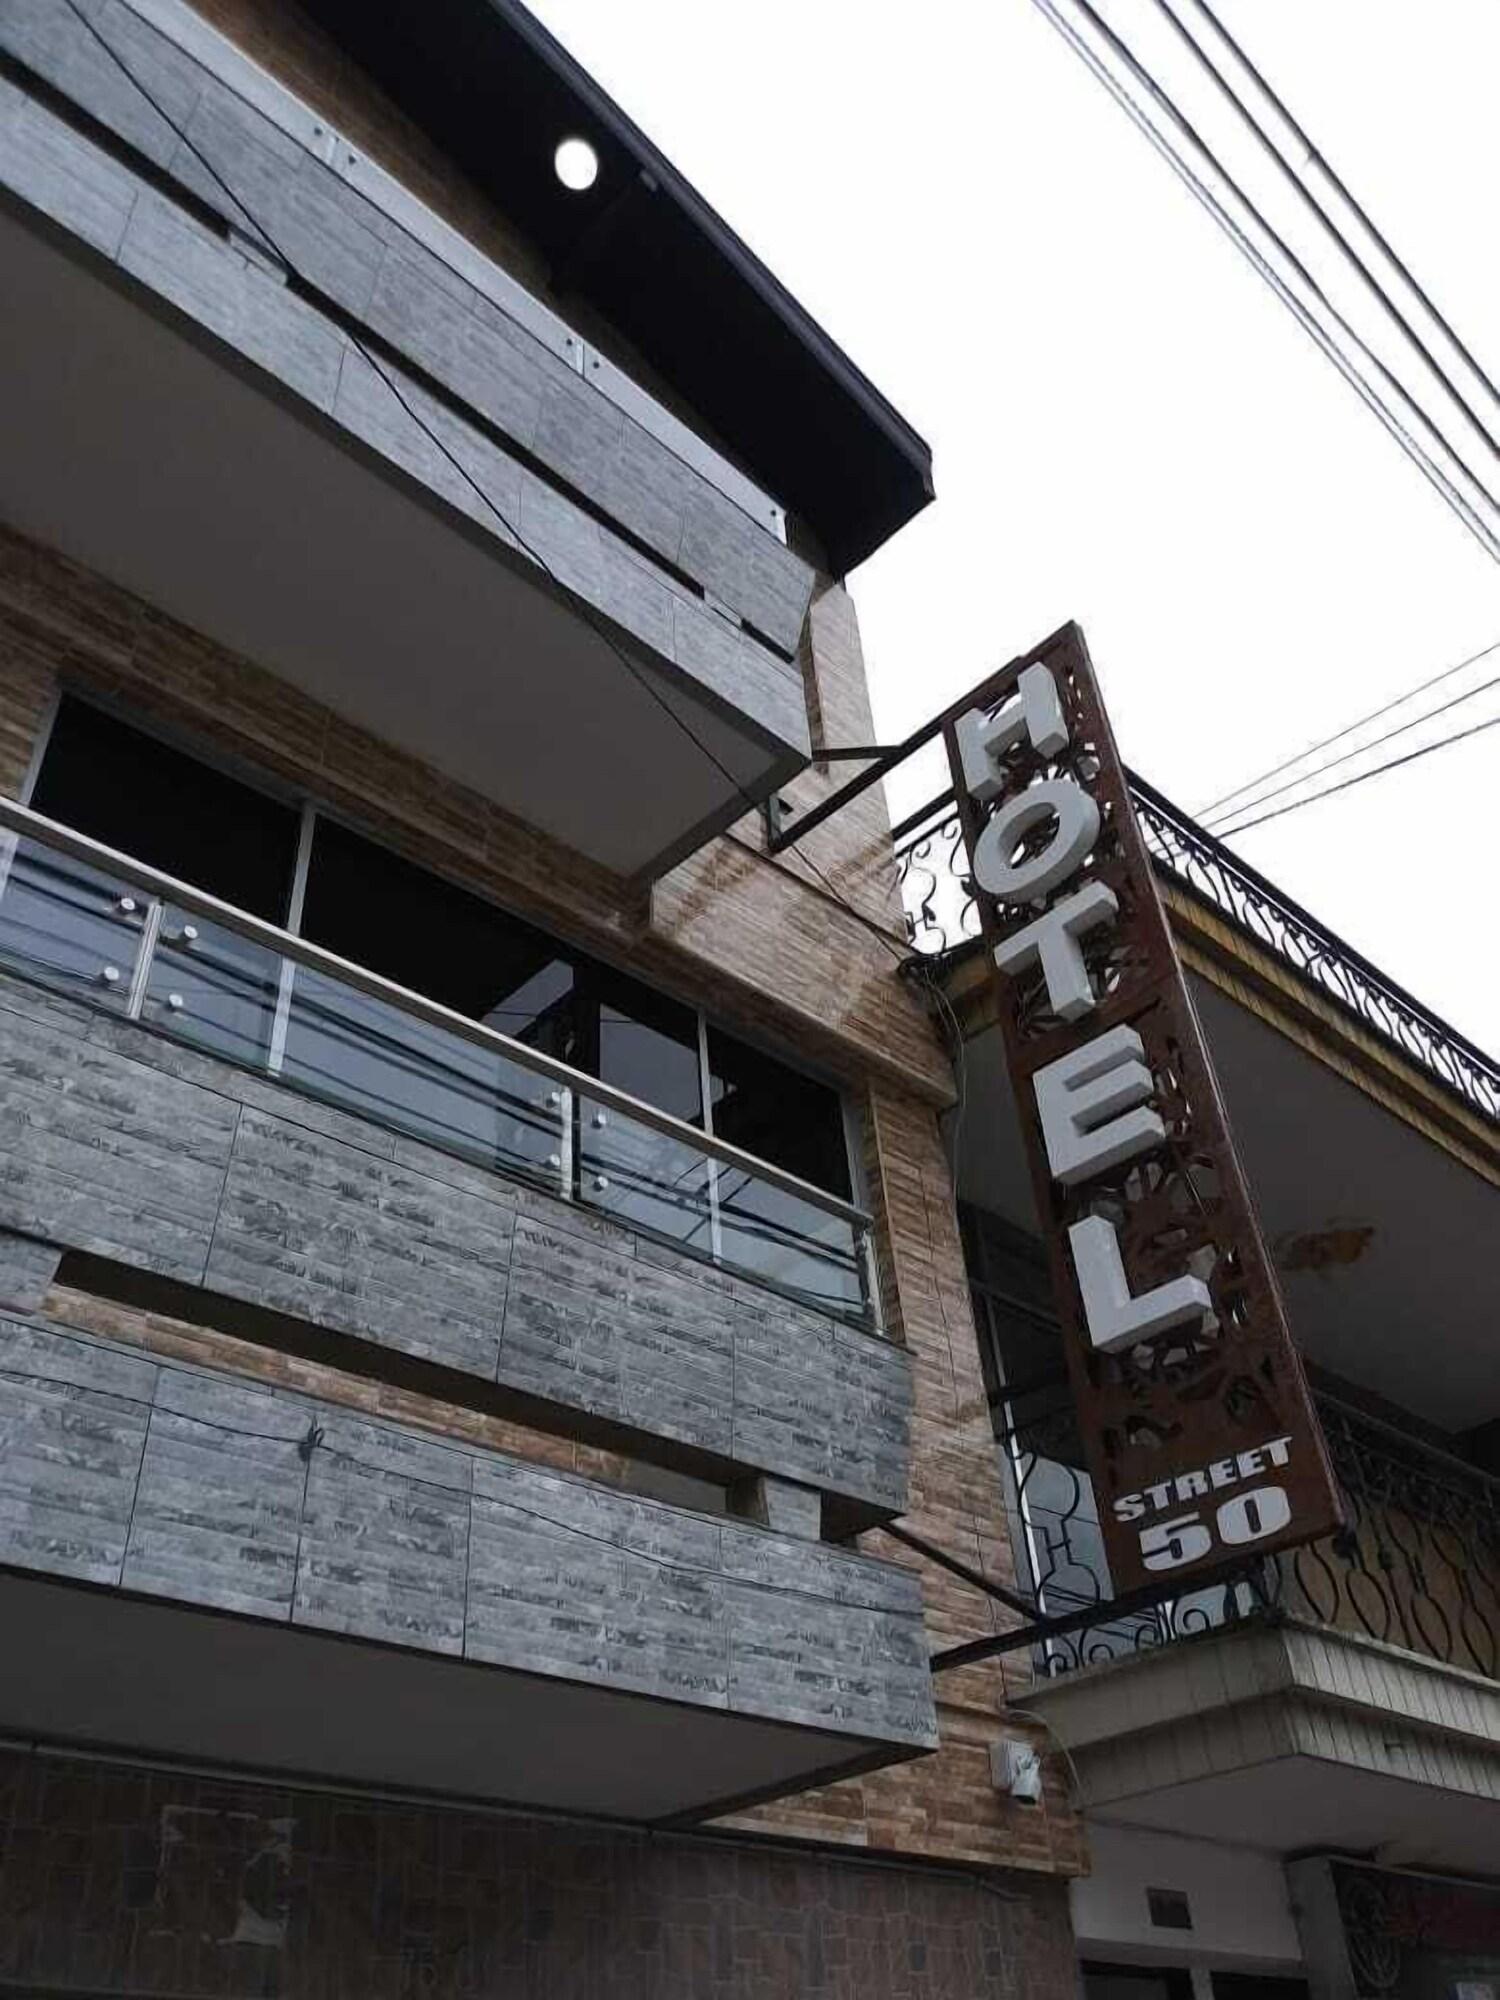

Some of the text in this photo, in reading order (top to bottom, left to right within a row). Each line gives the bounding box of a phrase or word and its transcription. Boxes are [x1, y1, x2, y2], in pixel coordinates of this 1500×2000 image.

[954, 661, 1212, 1353] HOTEL
[1113, 1436, 1293, 1522] STREET
[1139, 1486, 1292, 1571] 50
